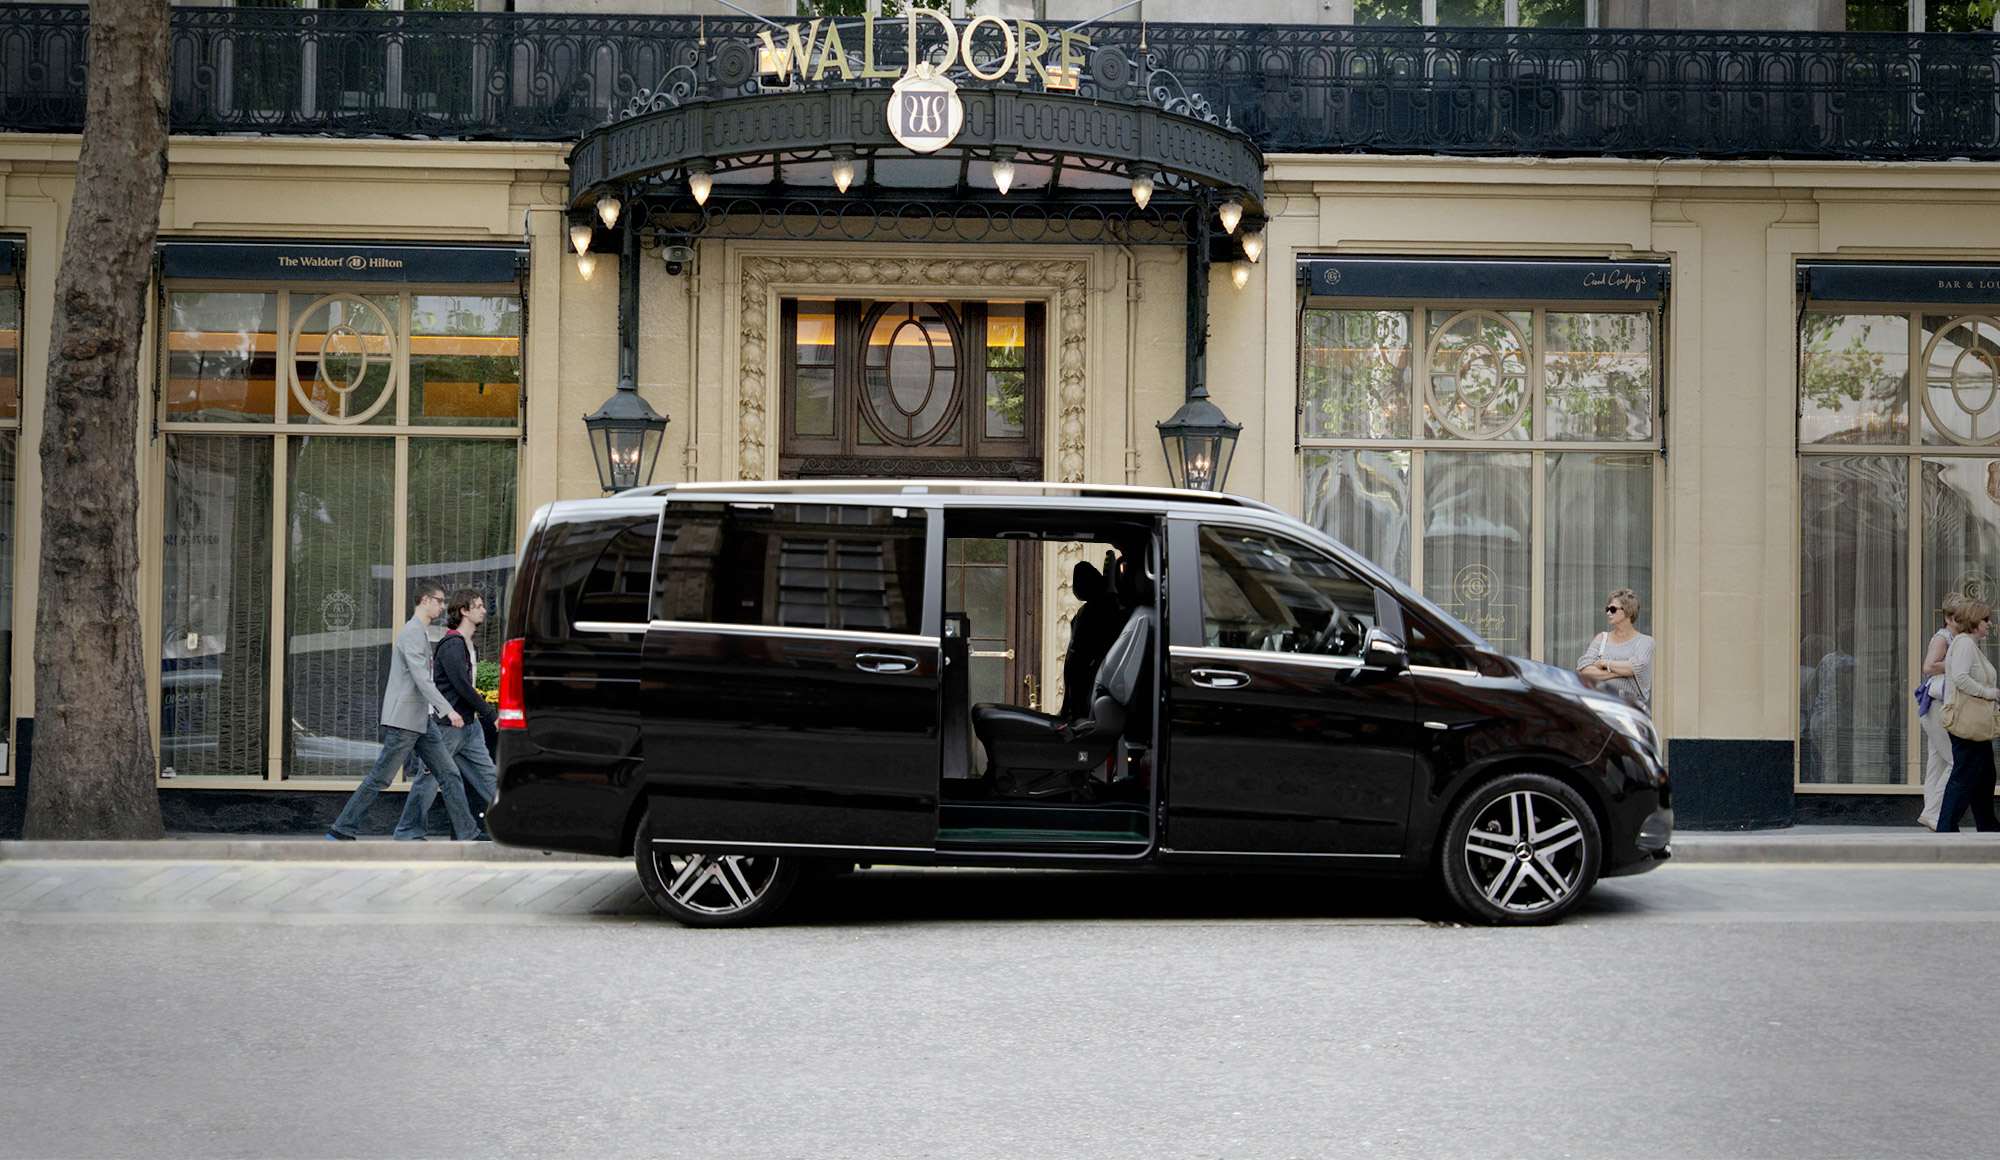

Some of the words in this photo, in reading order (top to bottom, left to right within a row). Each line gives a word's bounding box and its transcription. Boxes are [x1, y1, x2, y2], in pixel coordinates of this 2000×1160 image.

[757, 8, 1091, 88] WALDORF
[277, 256, 299, 267] The
[299, 256, 344, 267] Waldorf
[369, 257, 403, 268] Hilton
[1937, 280, 1961, 289] BAR
[1966, 280, 1974, 289] &
